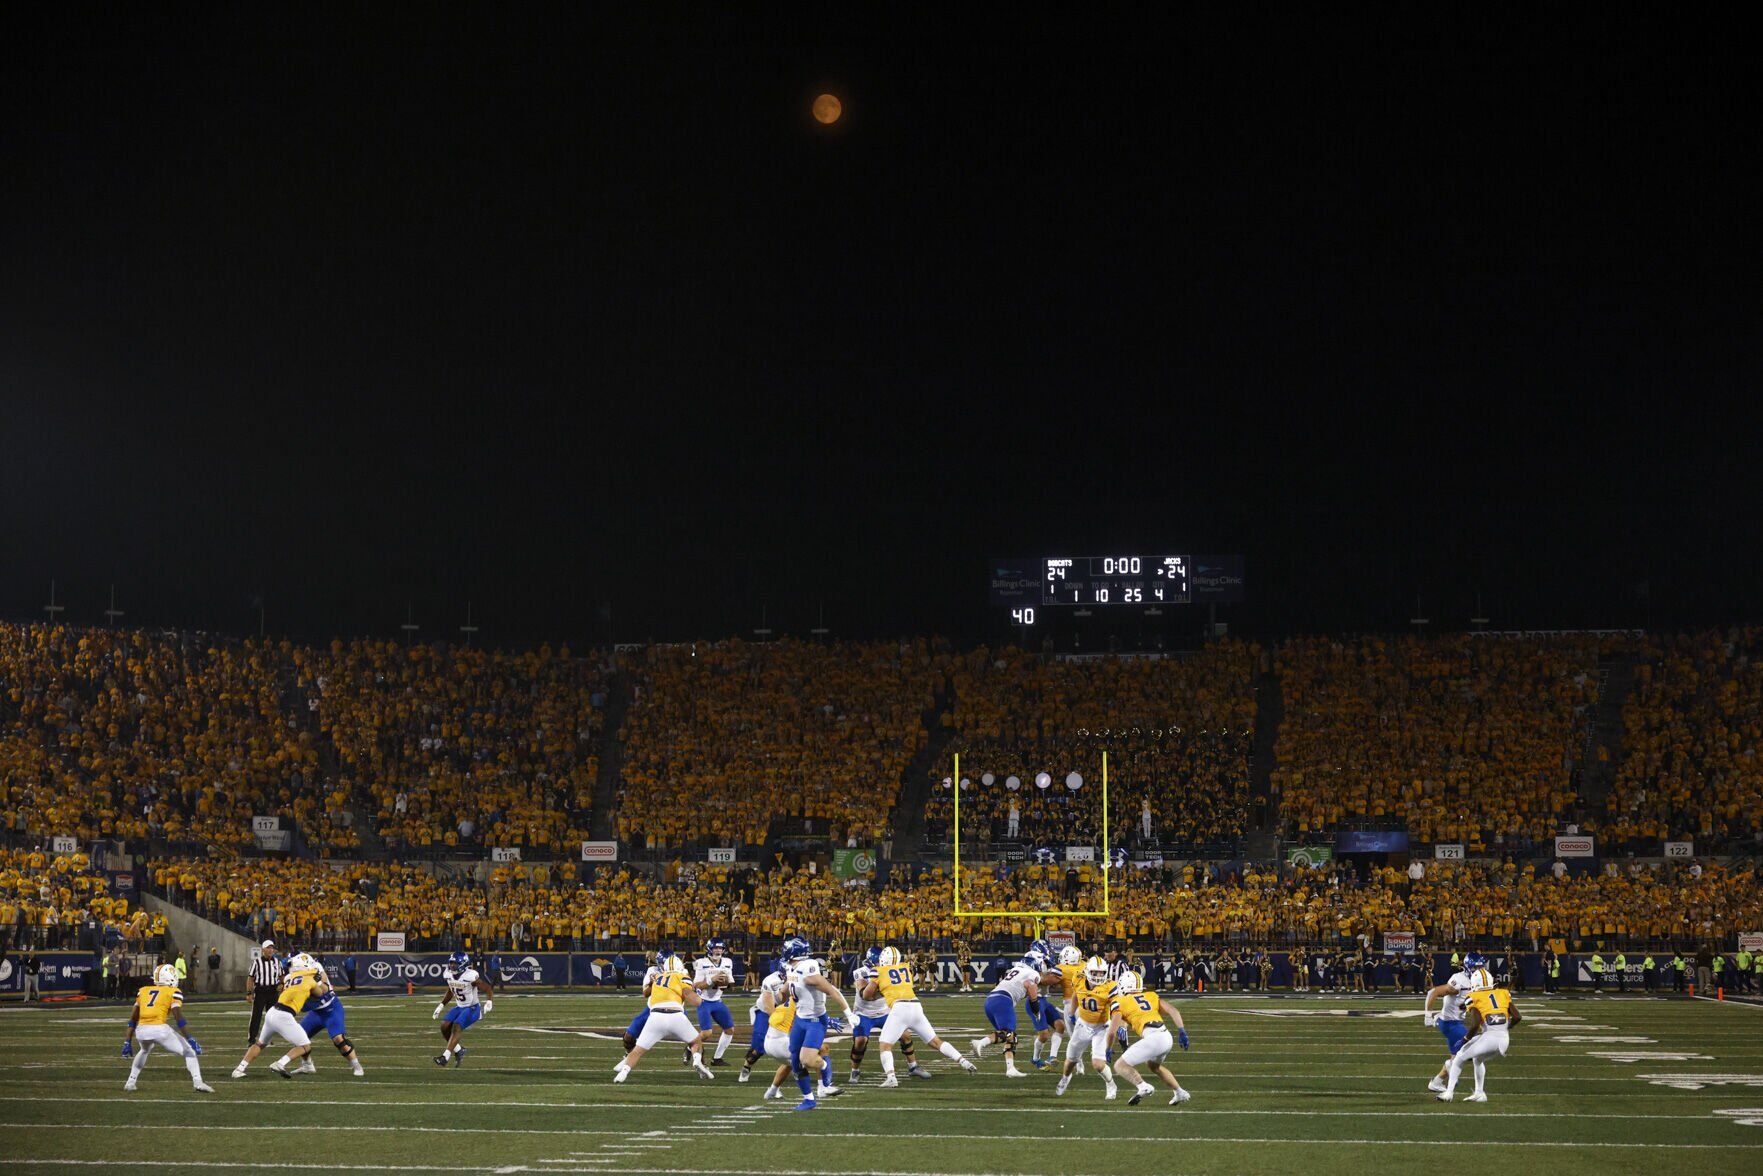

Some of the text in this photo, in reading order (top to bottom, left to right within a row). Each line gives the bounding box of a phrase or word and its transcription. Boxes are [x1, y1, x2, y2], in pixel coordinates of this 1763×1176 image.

[1047, 559, 1072, 567] BOBCATS
[1104, 557, 1140, 574] 0:00
[1163, 557, 1181, 565] JACKS
[1047, 567, 1065, 581] 24
[1168, 565, 1186, 579] 24
[992, 579, 1040, 590] Billings Clinic
[1182, 582, 1186, 592] 1
[1192, 576, 1242, 587] Billings Clinic
[1050, 584, 1054, 594] 1
[1096, 589, 1109, 602] 10
[1124, 588, 1142, 602] 25
[1155, 588, 1164, 601] 4
[1074, 590, 1078, 602] 1
[1012, 608, 1034, 624] 40
[58, 843, 72, 851] 116
[1670, 848, 1688, 856] 122
[714, 853, 730, 861] 119
[1441, 850, 1459, 858] 121
[395, 963, 448, 978] TOYO
[888, 967, 911, 985] 97
[655, 975, 671, 988] 41
[147, 990, 160, 1007] 7
[1081, 998, 1098, 1012] 10
[1134, 995, 1151, 1011] 5
[1488, 993, 1498, 1009] 1
